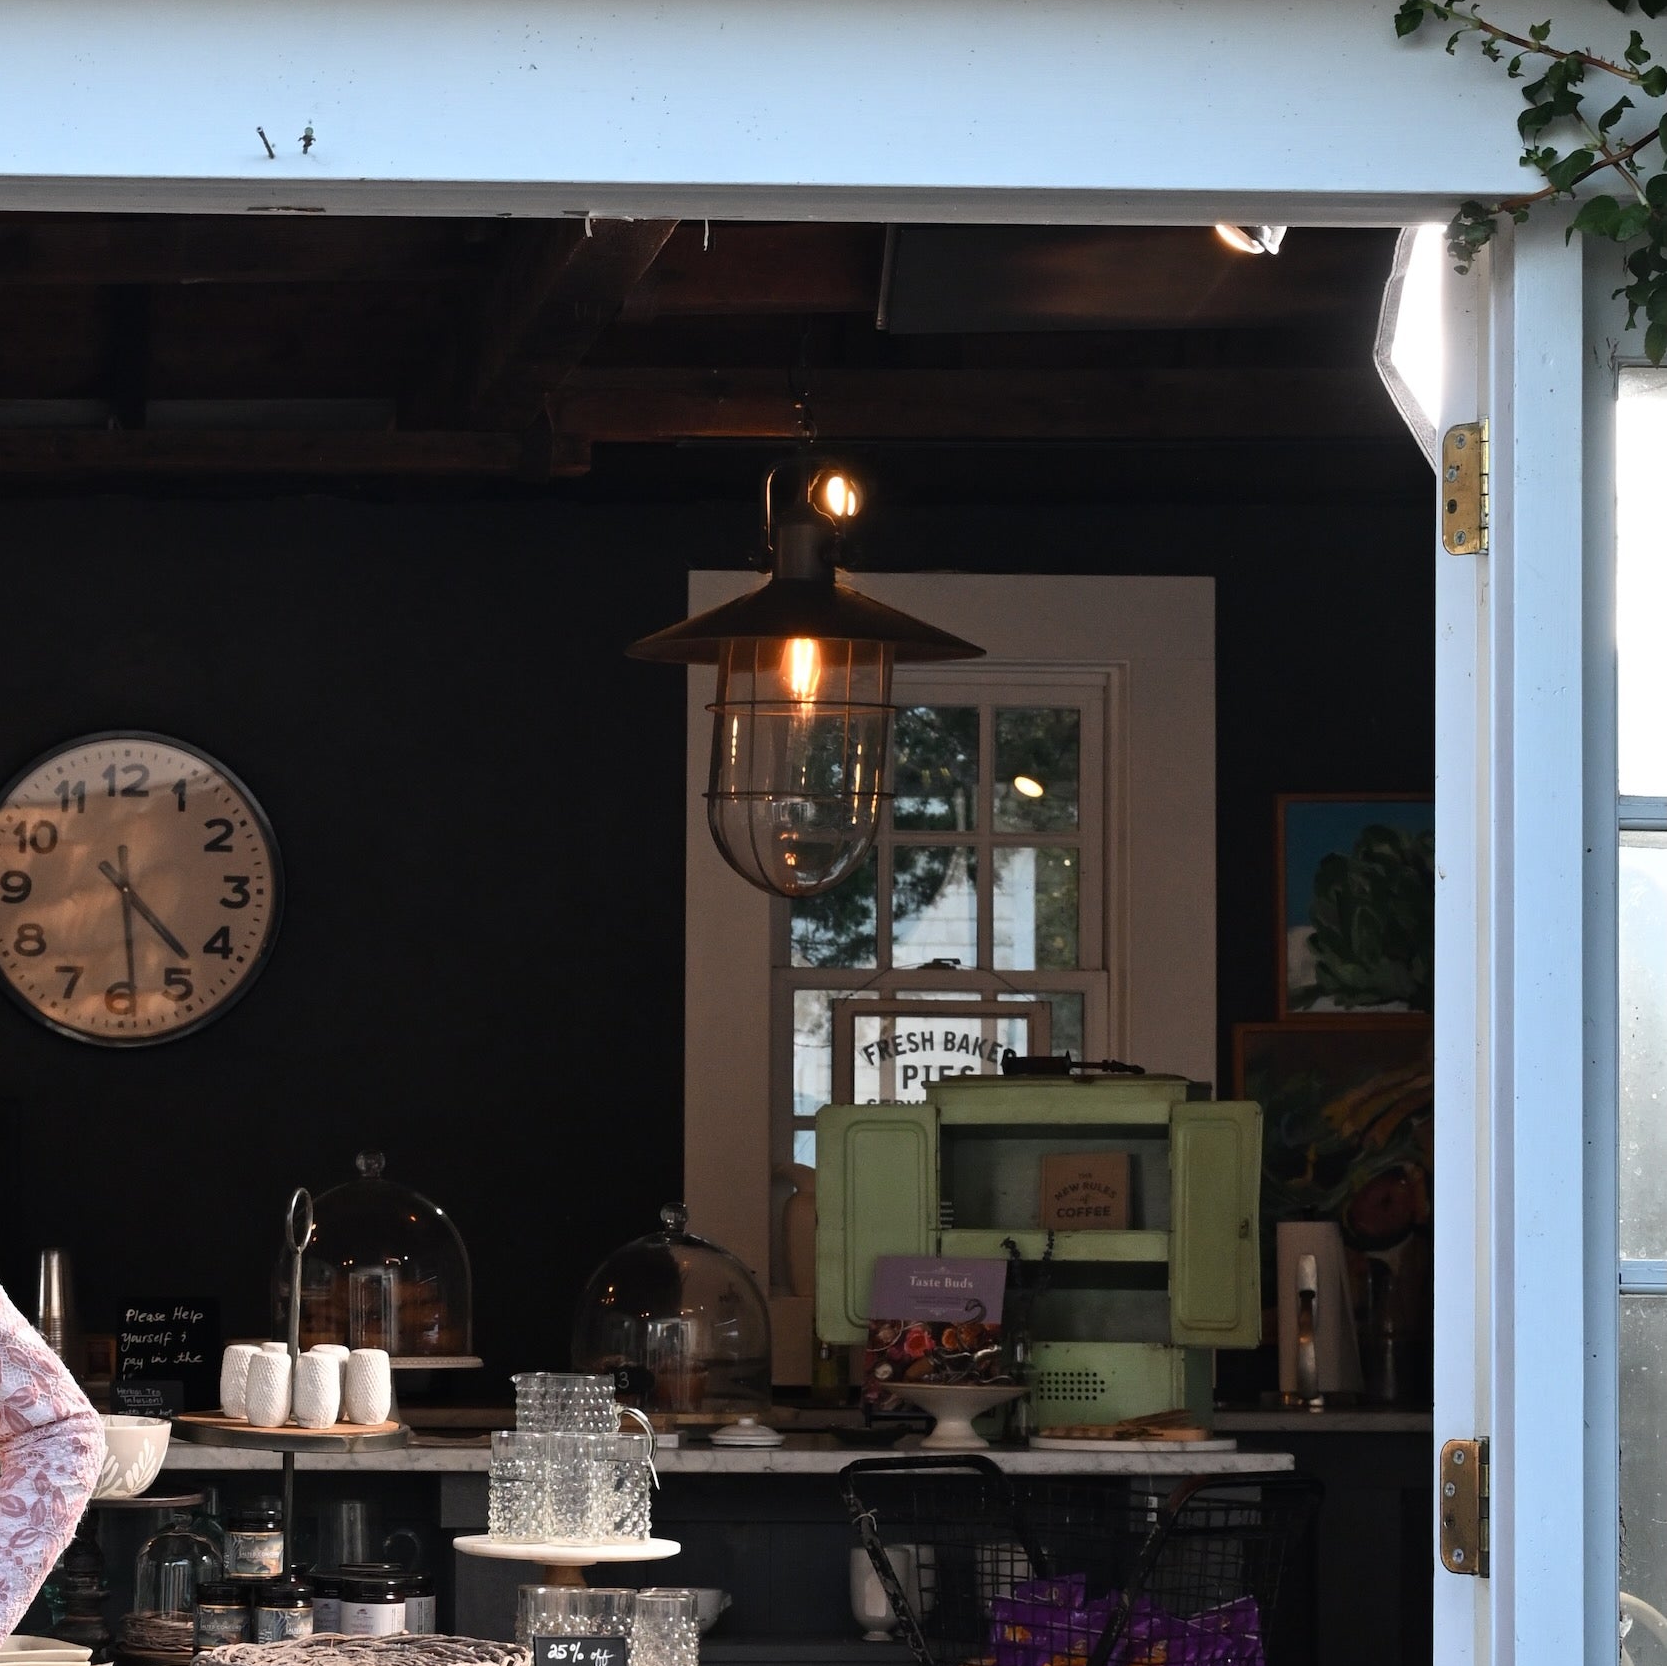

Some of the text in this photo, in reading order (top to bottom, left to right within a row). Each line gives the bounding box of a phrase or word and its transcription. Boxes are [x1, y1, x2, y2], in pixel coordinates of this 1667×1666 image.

[54, 779, 86, 813] 11
[101, 763, 150, 797] 12
[171, 778, 186, 812] 1
[13, 819, 58, 854] 10
[203, 818, 234, 853] 2
[0, 870, 32, 904] 9
[219, 875, 251, 909] 3
[13, 923, 47, 957] 8
[203, 926, 234, 960] 4
[54, 965, 85, 999] 7
[104, 980, 136, 1015] 6
[162, 967, 194, 1002] 5
[862, 1030, 935, 1066] FRESH
[1054, 1181, 1117, 1201] NEW RULES
[1056, 1205, 1111, 1218] COFFEE
[909, 1275, 974, 1289] Taste Buds
[125, 1305, 204, 1324] Please Help
[122, 1351, 204, 1372] pay in the
[547, 1641, 585, 1663] 25%
